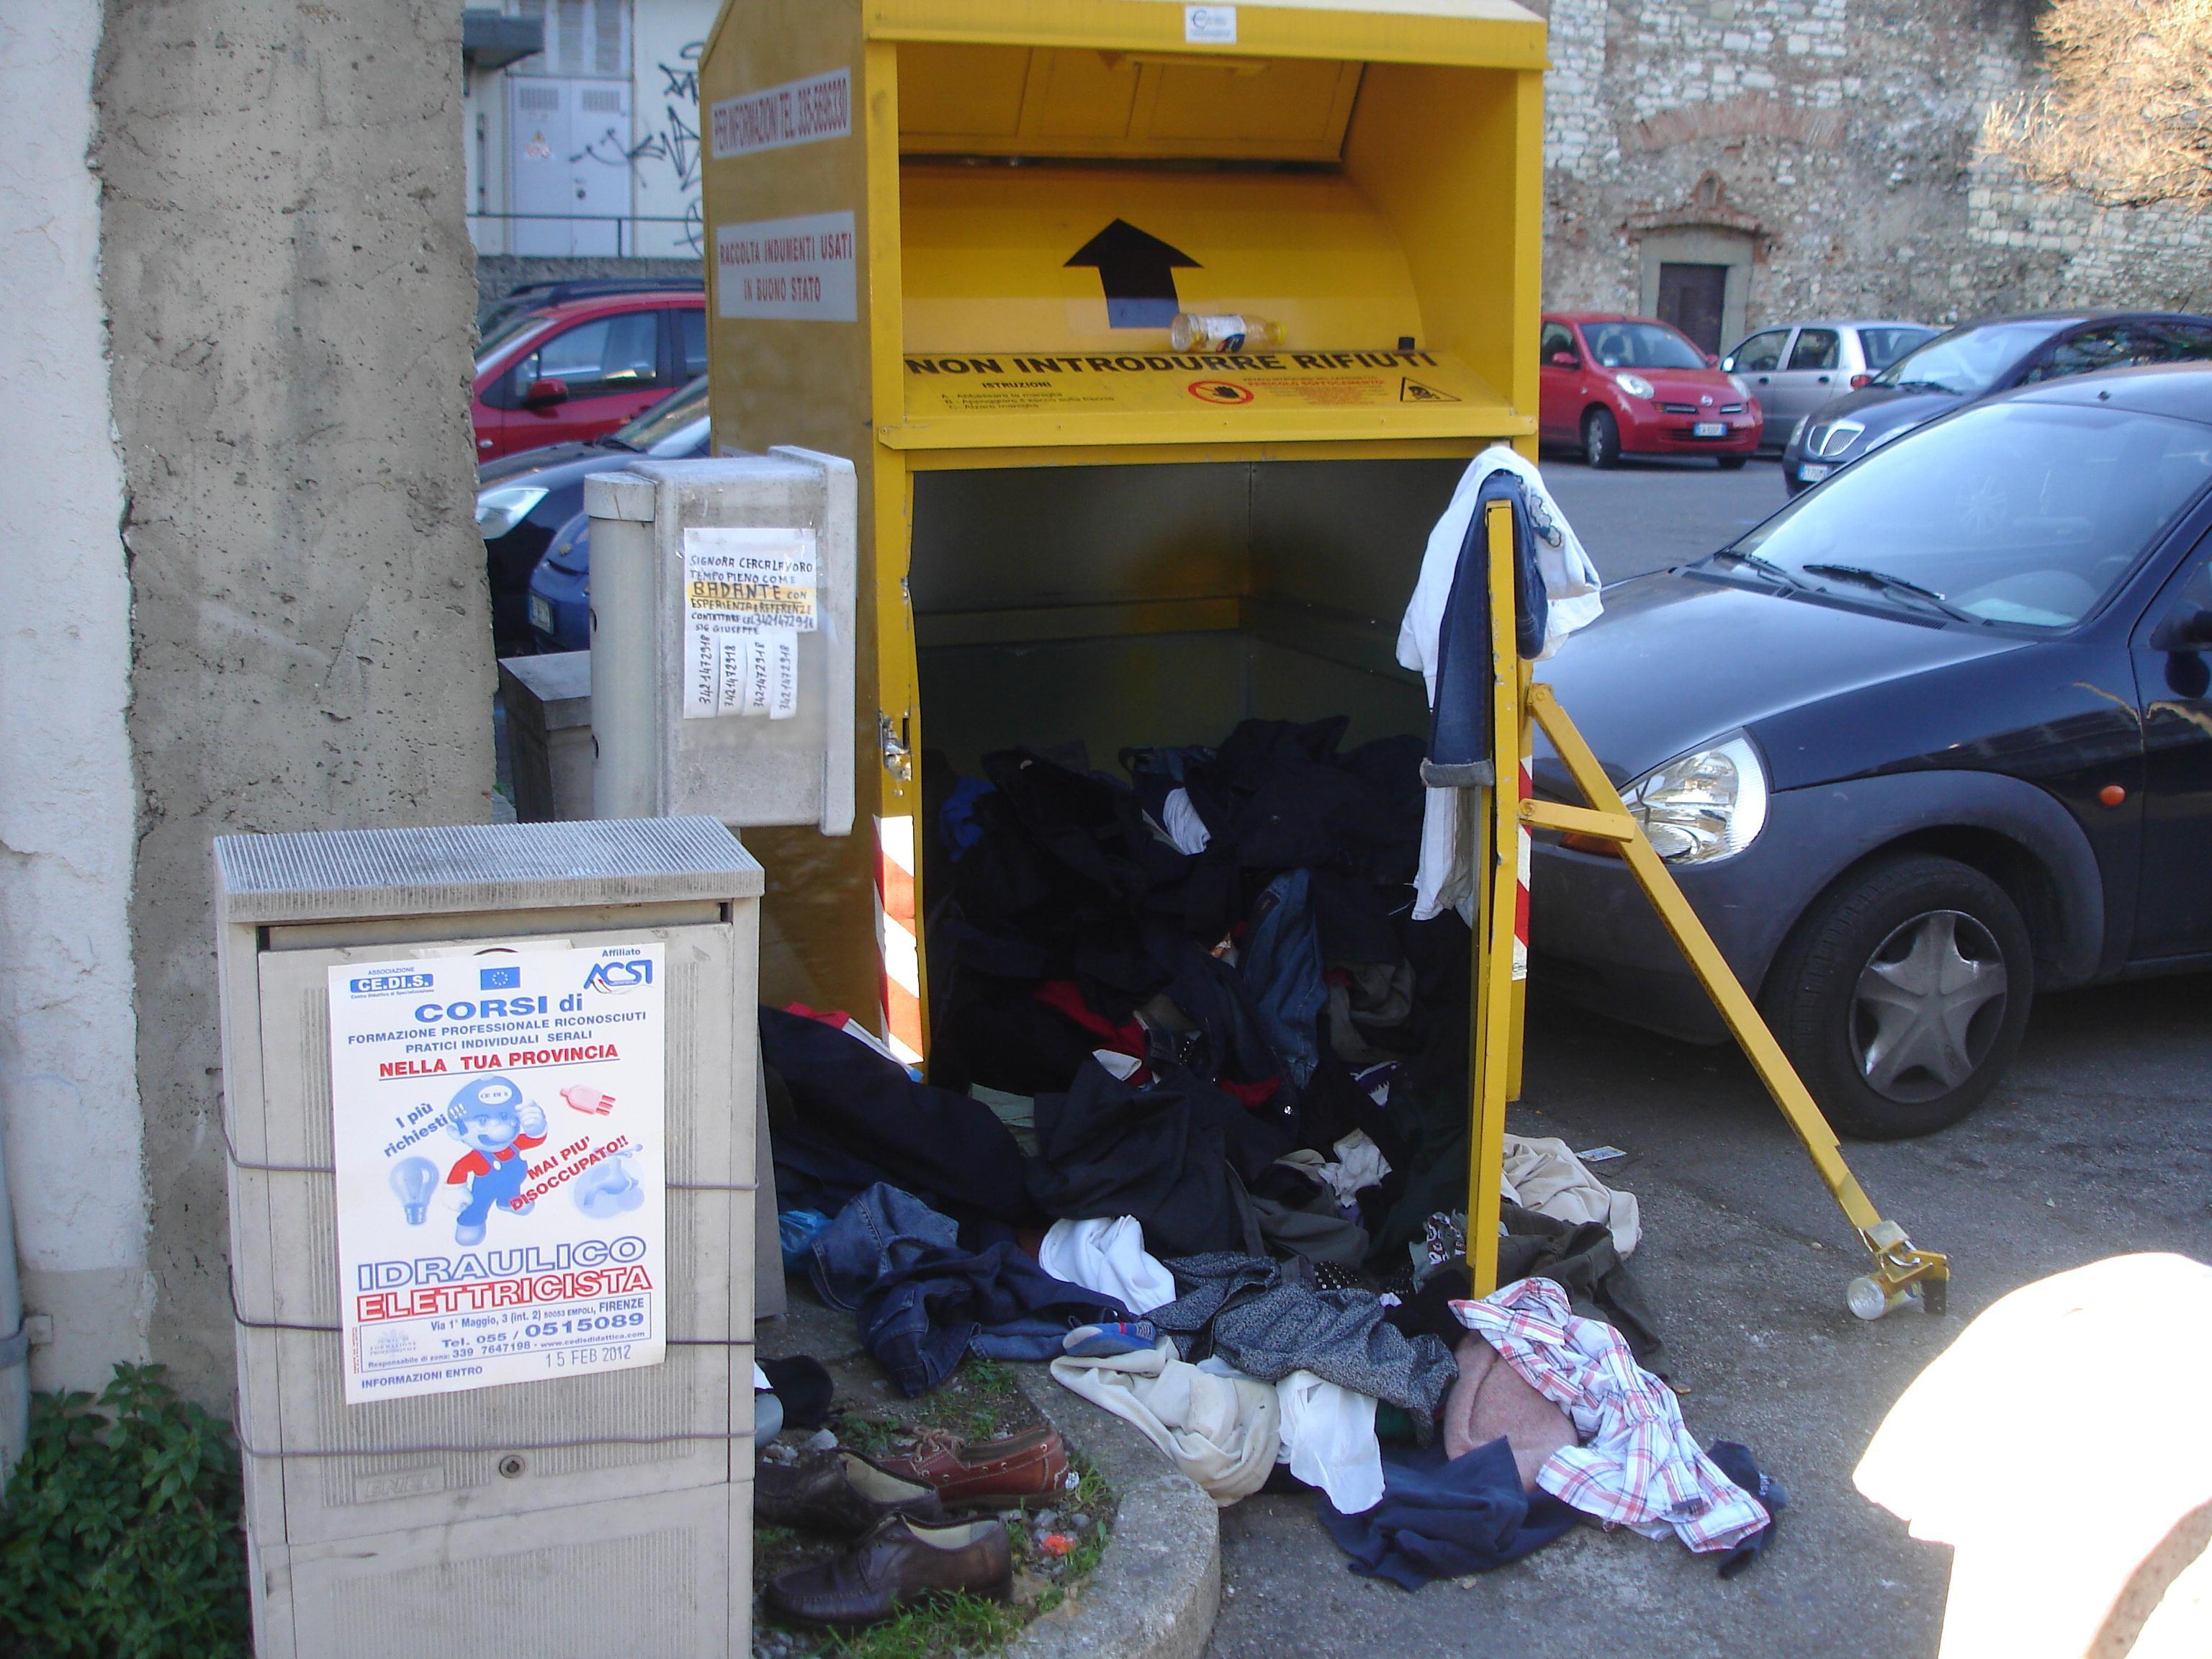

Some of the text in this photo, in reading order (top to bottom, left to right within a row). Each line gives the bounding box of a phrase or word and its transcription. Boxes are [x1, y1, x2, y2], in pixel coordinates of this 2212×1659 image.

[720, 233, 852, 266] RACCOLTA INDUMENTI USATI
[744, 276, 821, 302] IN BUONO STATO
[904, 353, 1439, 374] NON INTRODURRE RIFIUTI
[691, 555, 734, 568] SIGNORA
[690, 570, 724, 580] TEMPO
[727, 572, 759, 583] PIENO
[693, 581, 781, 601] BADANTE
[691, 598, 752, 611] ESPERIENZA
[602, 948, 640, 957] Affiliato
[358, 975, 429, 991] CE.DI.S.
[415, 994, 582, 1023] CORSI di
[348, 1011, 646, 1044] FORMAZIONE PROFESSIONALE RICONOSCIUTI
[406, 1030, 592, 1053] PRATICI INDIVIDUALI SERALI
[379, 1044, 619, 1076] NELLA TUA PROVINCIA
[396, 1102, 433, 1128] I più
[527, 1136, 590, 1180] MAI PIU'
[508, 1135, 629, 1210] DISOCCUPATO!!
[358, 1236, 647, 1292] IDRAULICO
[356, 1265, 653, 1323] ELETTRICISTA
[431, 1321, 446, 1331] Via
[462, 1316, 499, 1329] Maggio,
[502, 1314, 508, 1323] 3
[511, 1311, 529, 1323] (int.
[532, 1309, 541, 1321] 2)
[567, 1307, 596, 1316] EMPOLI,
[599, 1298, 644, 1313] FIRENZE
[441, 1337, 469, 1348] Tel.
[476, 1332, 507, 1344] 055
[525, 1312, 644, 1338] 0515089
[369, 1357, 419, 1369] Responsabile
[452, 1348, 474, 1359] 339
[481, 1341, 531, 1355] 7647198
[572, 1348, 598, 1365] FEB
[603, 1344, 631, 1362] 2012
[361, 1366, 483, 1389] INFORMAZIONI ENTRO
